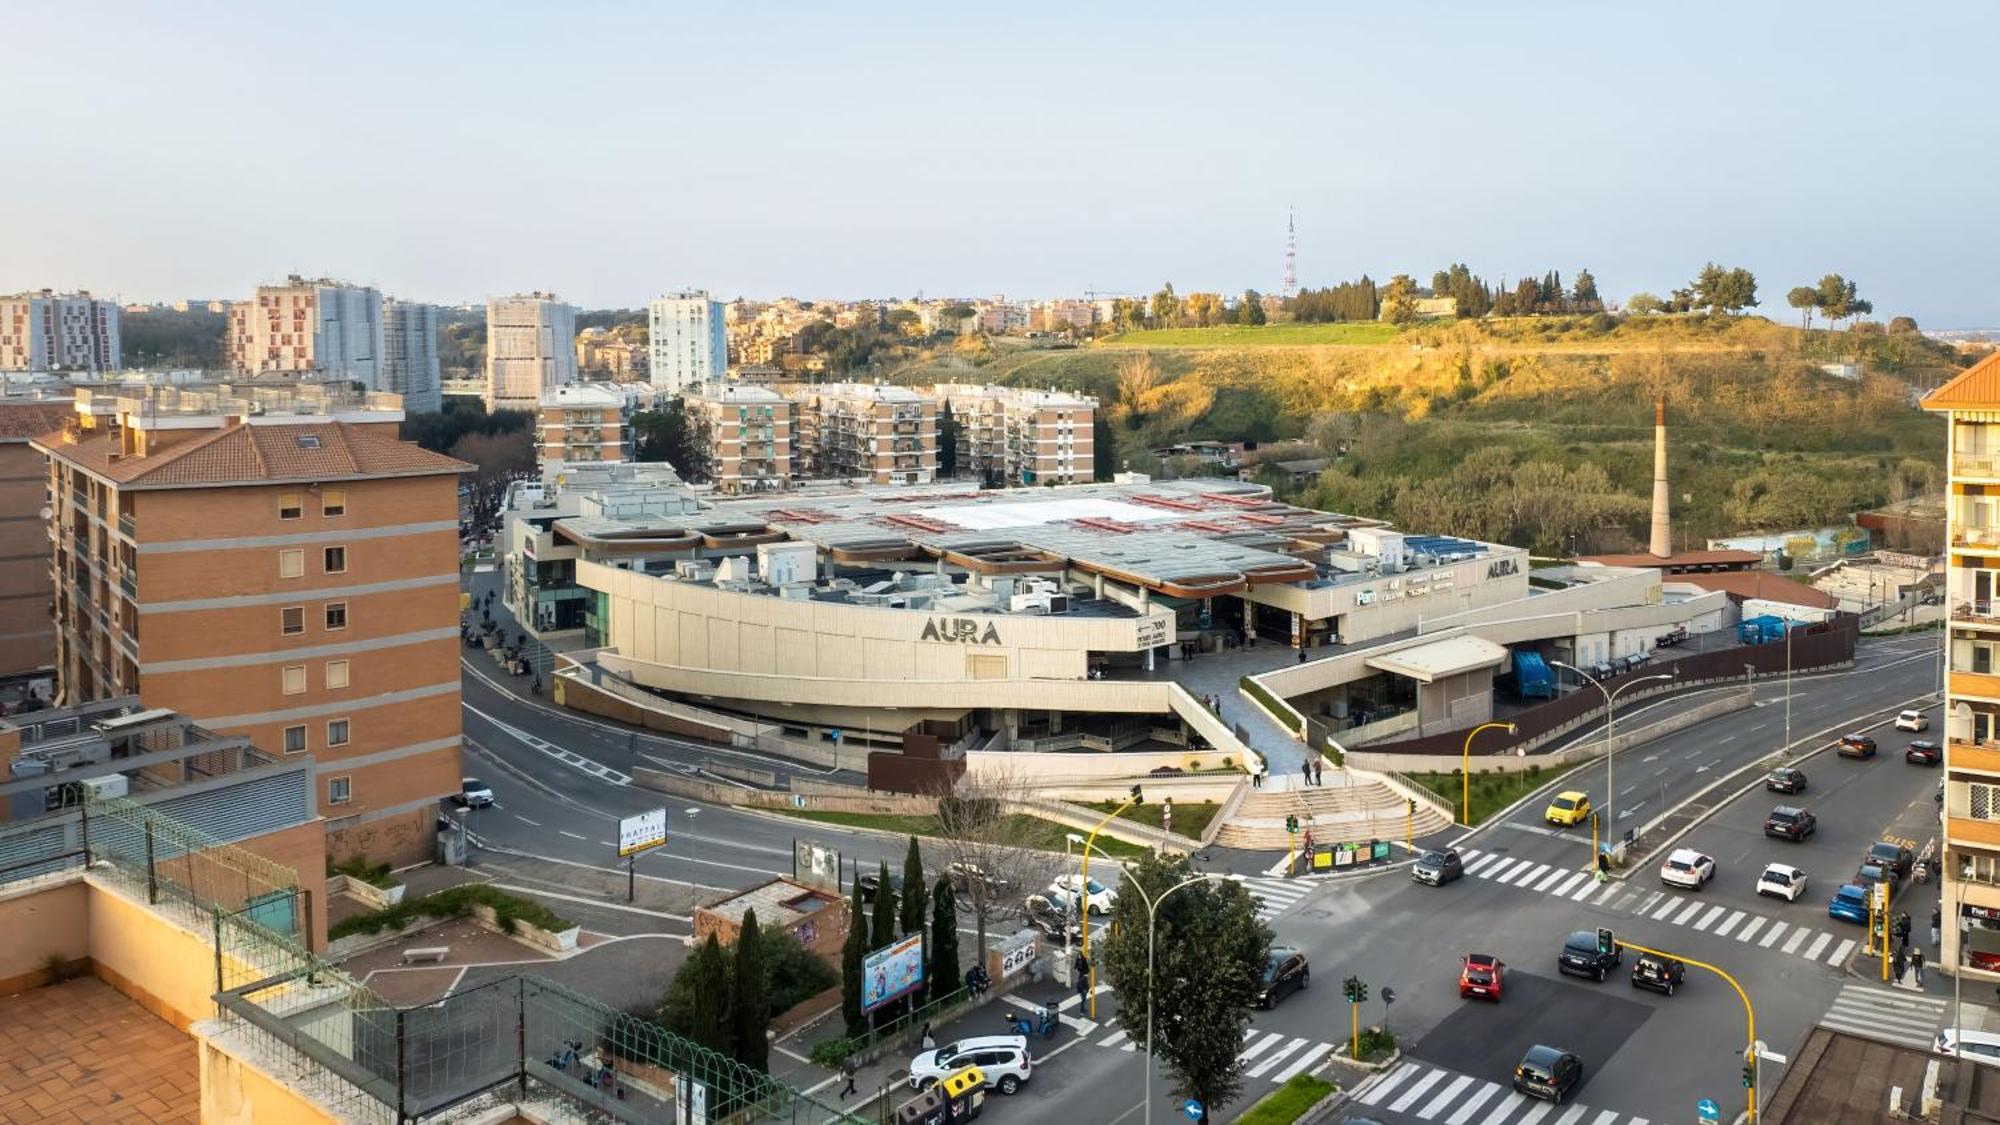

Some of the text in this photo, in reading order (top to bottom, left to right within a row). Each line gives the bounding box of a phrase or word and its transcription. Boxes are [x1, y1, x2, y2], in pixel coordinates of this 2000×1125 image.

[1486, 558, 1519, 579] AURA
[921, 616, 1002, 645] AURA
[1883, 832, 1917, 850] BUS
